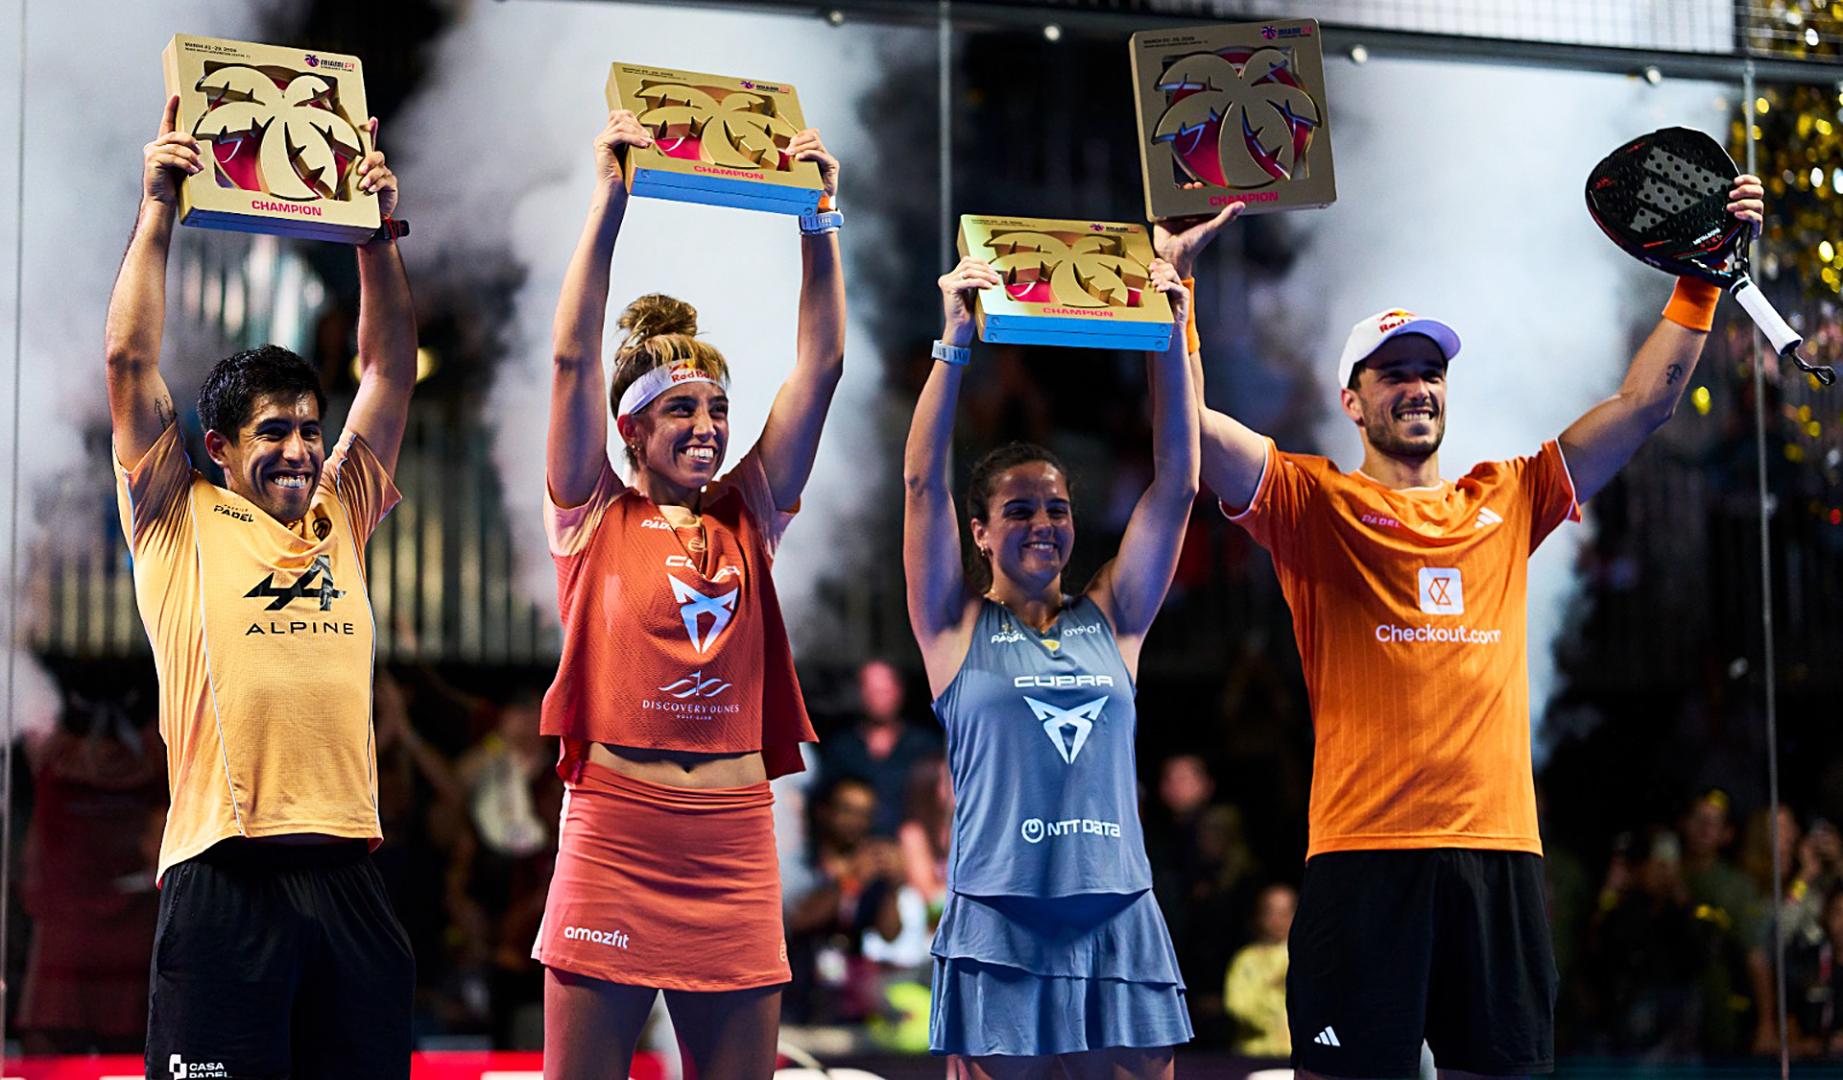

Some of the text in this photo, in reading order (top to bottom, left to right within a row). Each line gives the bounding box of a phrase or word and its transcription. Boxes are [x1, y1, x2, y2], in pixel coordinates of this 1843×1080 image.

[694, 165, 764, 180] CHAMPION
[1208, 191, 1279, 206] CHAMPION
[251, 200, 322, 216] CHAMPION
[1043, 307, 1114, 317] CHAMPION
[671, 370, 695, 383] Red
[213, 504, 254, 523] PADEL
[245, 621, 355, 636] ALPINE
[1375, 623, 1501, 645] Checkout.com
[1014, 675, 1114, 689] CUPRA
[642, 699, 708, 713] DISCOVERY
[1047, 819, 1081, 836] NTT
[563, 926, 630, 949] amazfit
[189, 1062, 225, 1071] CASA
[189, 1071, 233, 1079] PADEL
